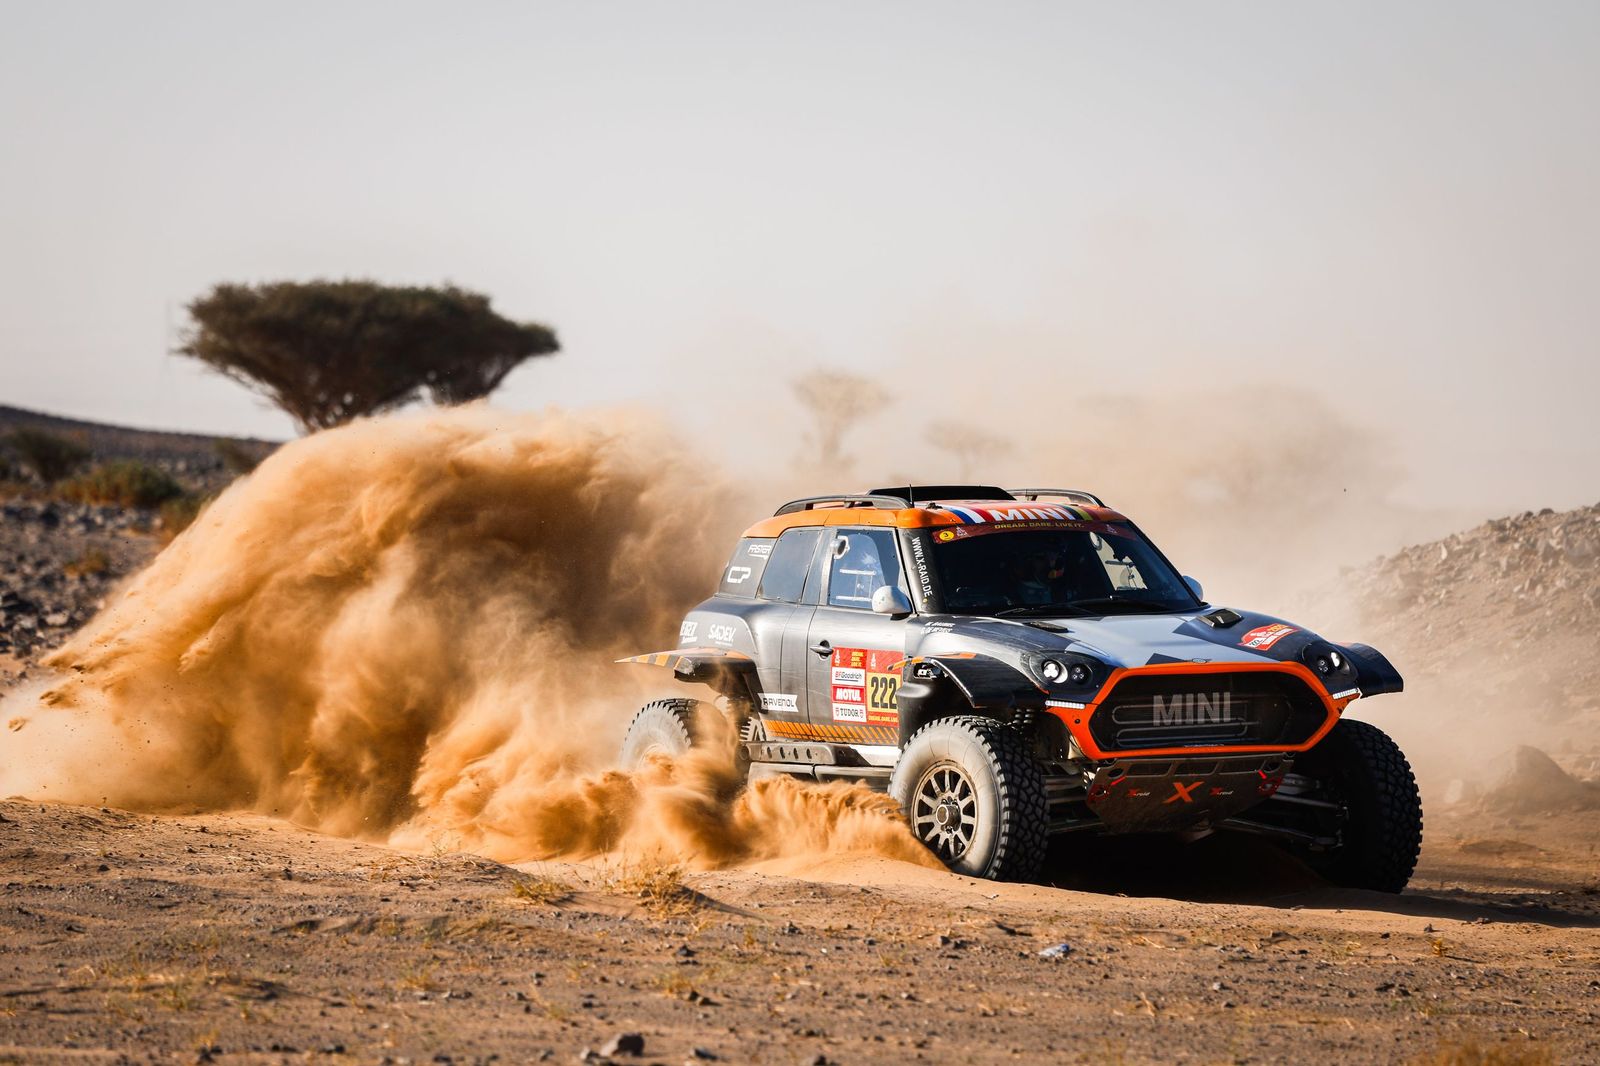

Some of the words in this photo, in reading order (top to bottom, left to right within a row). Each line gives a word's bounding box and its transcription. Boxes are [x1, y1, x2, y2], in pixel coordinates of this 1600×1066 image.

[988, 508, 1076, 521] MINI
[911, 536, 933, 598] WWW.X-RAID.DE
[835, 671, 862, 679] BFGoodrich
[836, 688, 861, 701] MOTUL
[871, 676, 897, 709] 222
[762, 697, 795, 708] RAVENOL
[1153, 692, 1231, 726] MINI
[840, 707, 859, 717] TUDOR
